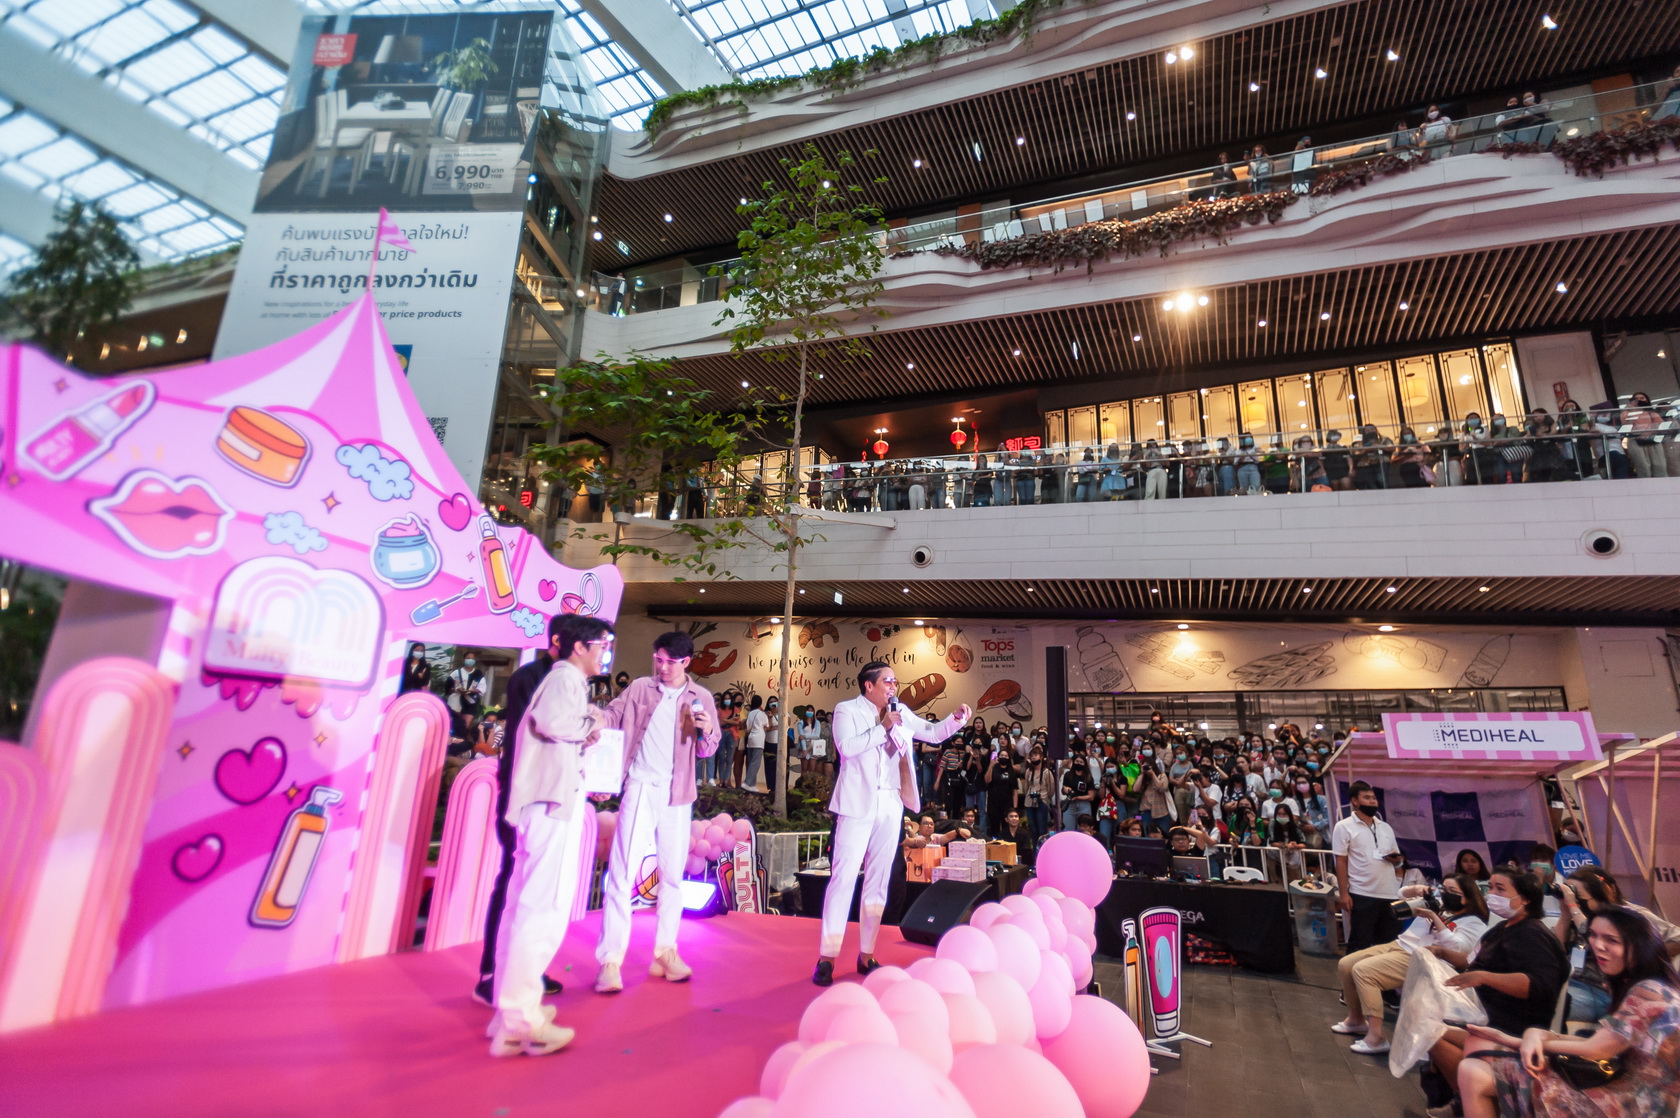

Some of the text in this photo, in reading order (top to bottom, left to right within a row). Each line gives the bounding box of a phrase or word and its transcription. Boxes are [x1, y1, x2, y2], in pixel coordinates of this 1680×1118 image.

[435, 164, 491, 181] 6,990
[458, 182, 485, 190] 7,990
[281, 224, 469, 241] ค้นพบแรงบัาลใจใหม่!
[388, 310, 415, 320] price
[416, 310, 462, 320] products
[980, 639, 1015, 655] Tops
[748, 645, 917, 673] We prmise you the best in
[980, 653, 1015, 662] market
[767, 670, 812, 696] Qulity
[817, 671, 842, 690] and
[1440, 729, 1545, 742] MEDIHEAL
[1559, 852, 1578, 860] LOVE
[1560, 859, 1594, 869] LOVE
[1180, 910, 1206, 923] EGA
